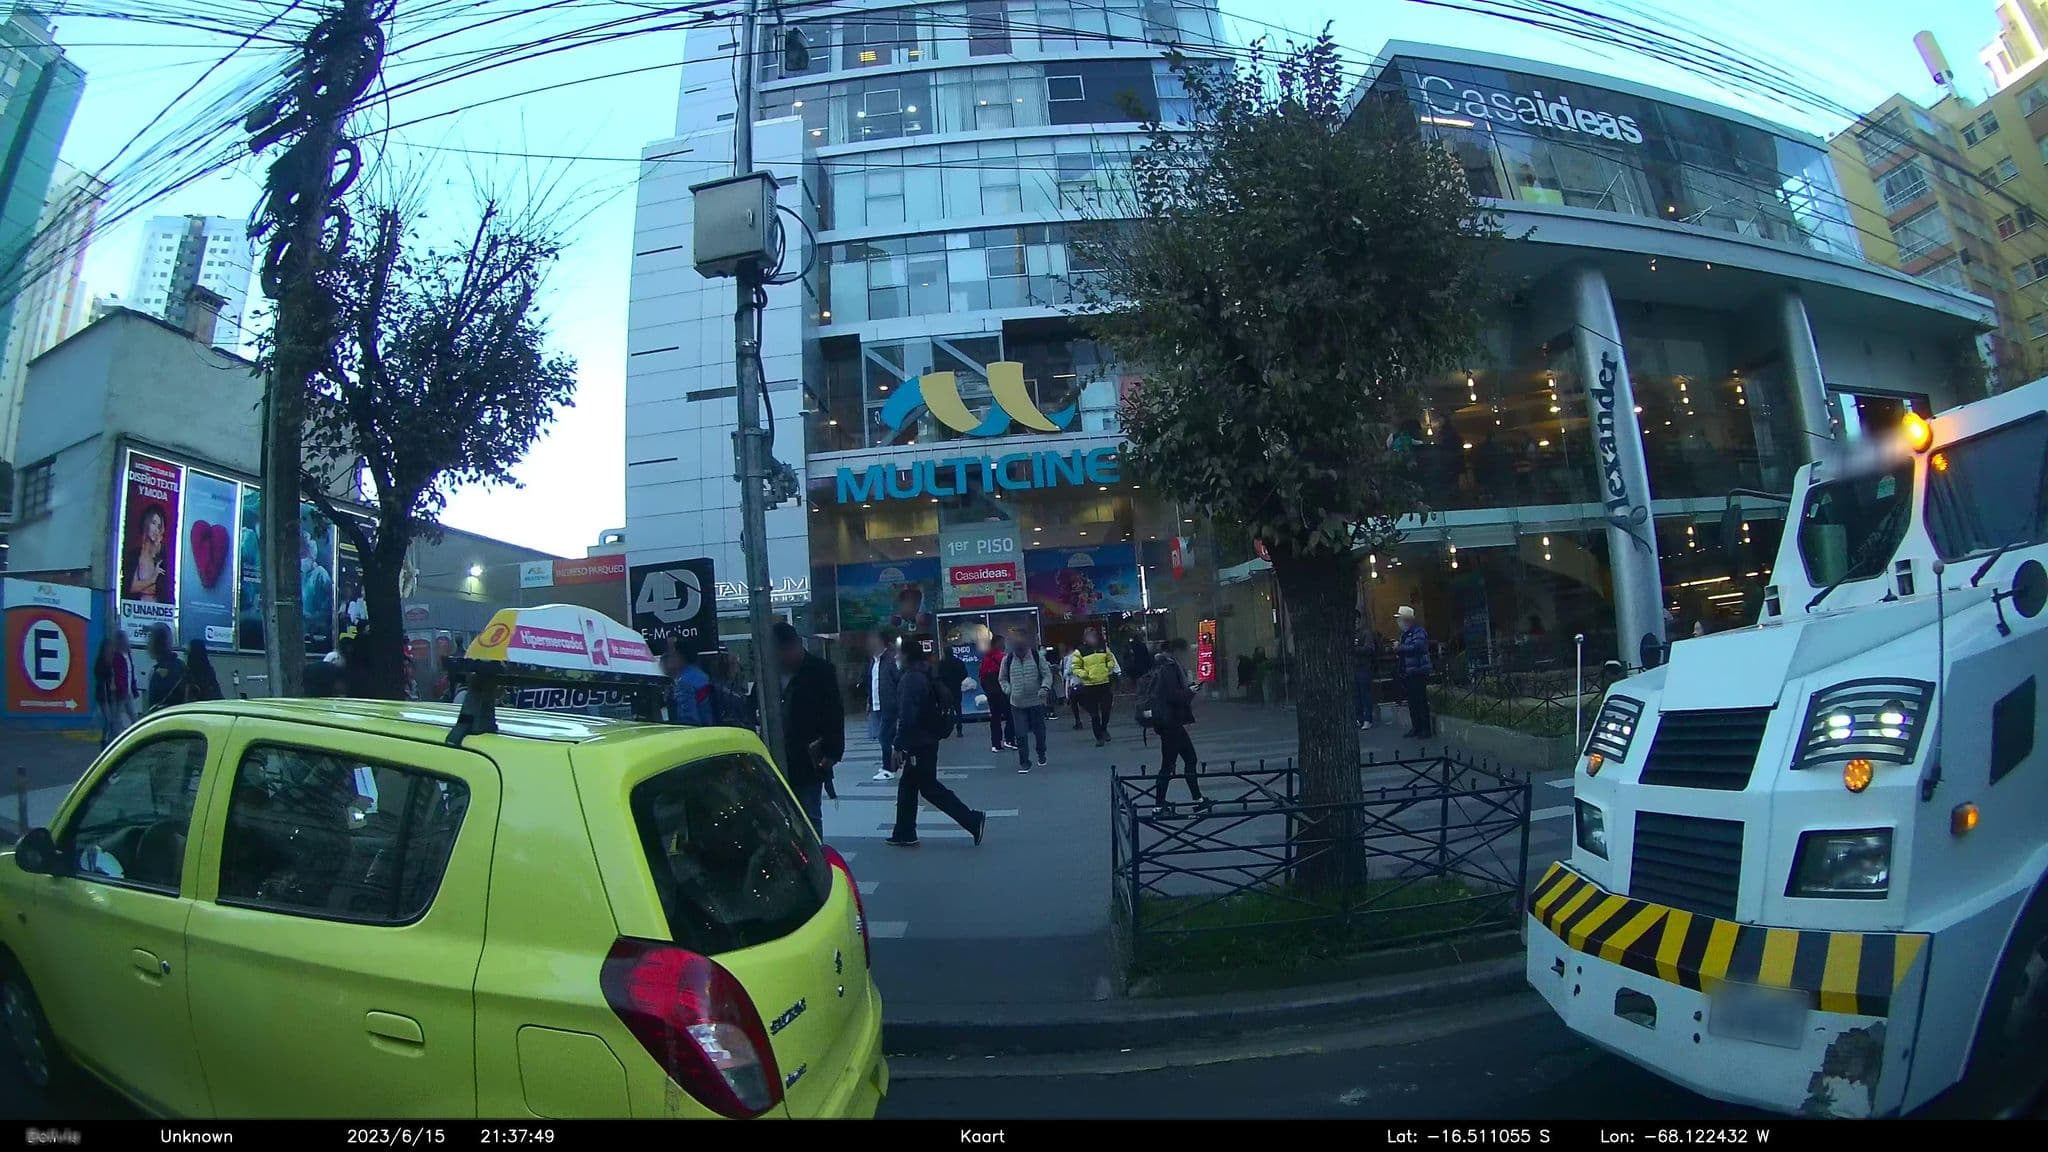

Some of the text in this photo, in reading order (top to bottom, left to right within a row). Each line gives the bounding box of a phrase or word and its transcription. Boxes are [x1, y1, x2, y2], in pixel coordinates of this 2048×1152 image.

[1421, 75, 1644, 145] Casaideas
[129, 470, 180, 493] DISEÑO TEXTIL
[836, 446, 1120, 504] MULTICINE
[948, 537, 1014, 557] 1er PISO
[588, 564, 625, 576] PARQUEO
[715, 576, 809, 597] TANUM
[133, 603, 174, 618] UNANDES
[35, 628, 61, 681] E
